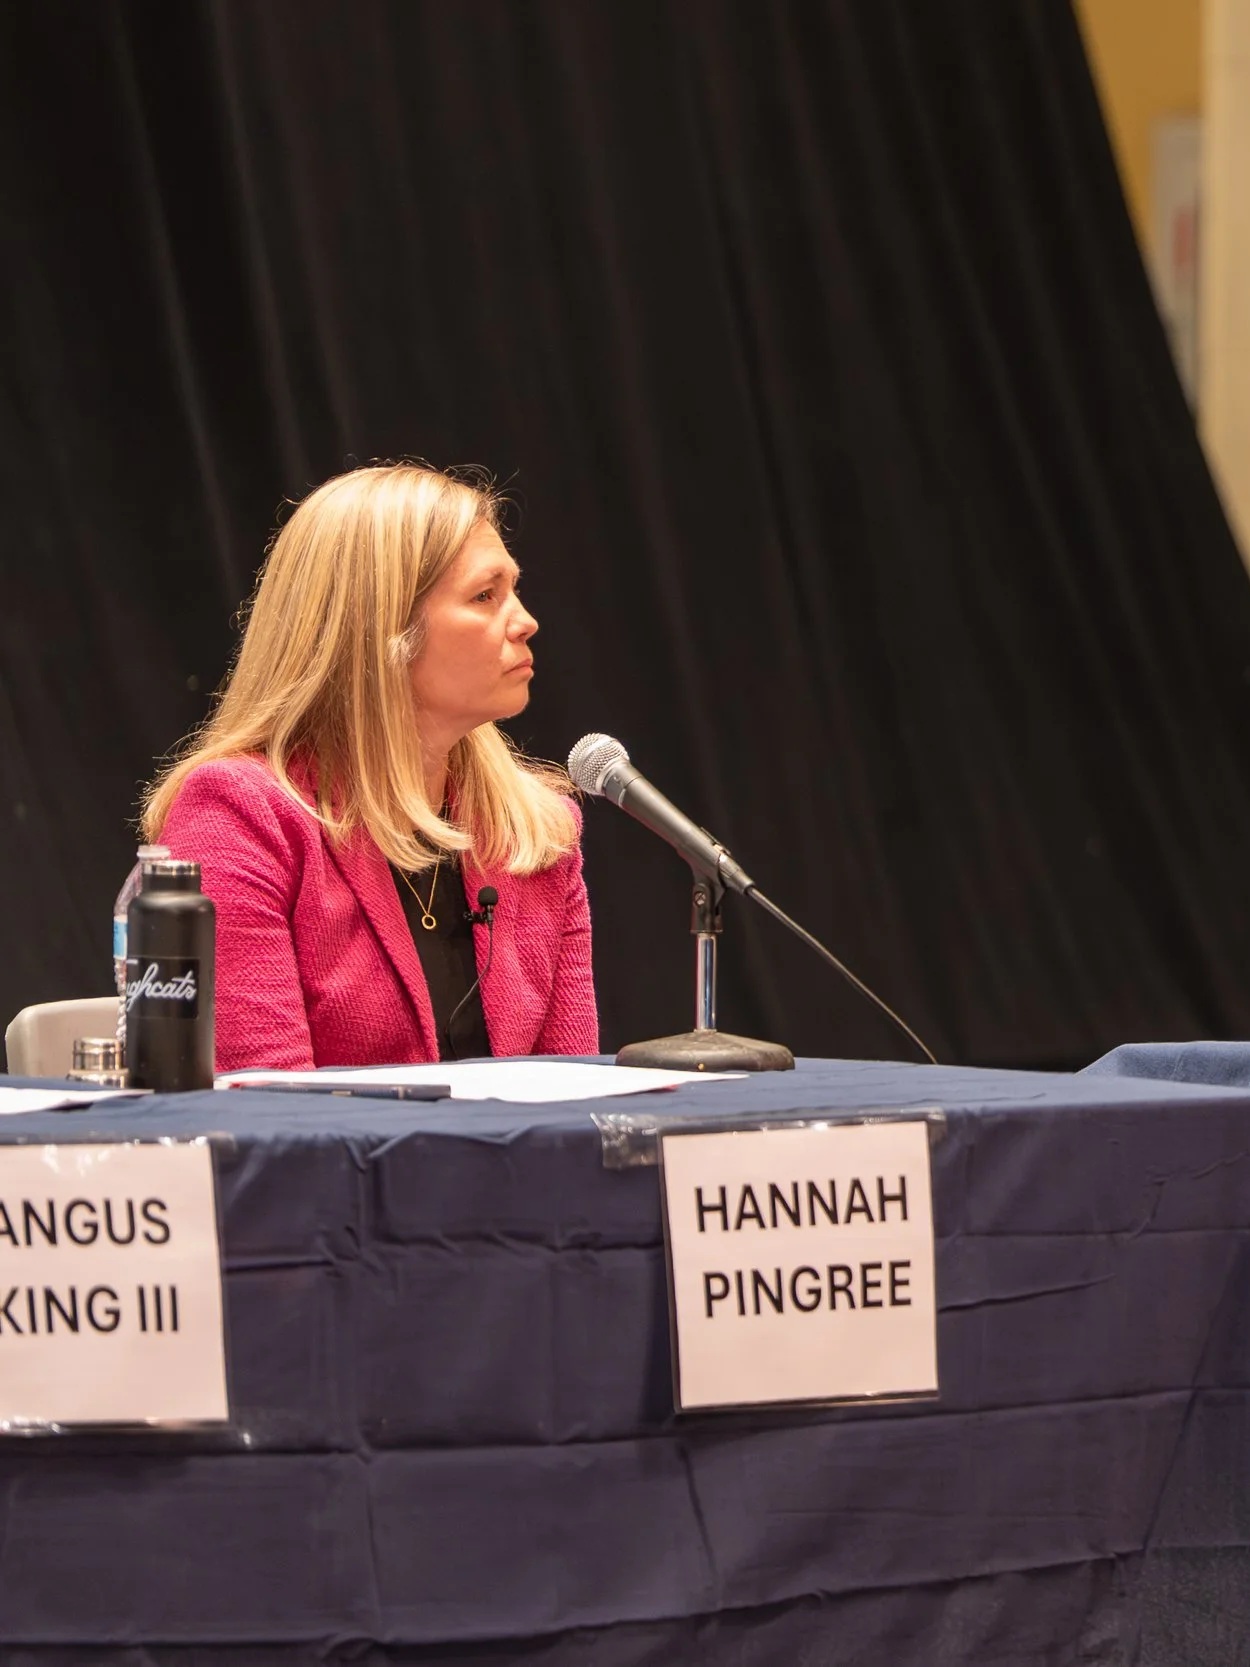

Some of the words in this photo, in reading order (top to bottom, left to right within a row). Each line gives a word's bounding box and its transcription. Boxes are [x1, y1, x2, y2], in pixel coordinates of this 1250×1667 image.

[126, 959, 197, 1012] ghcats
[695, 1175, 909, 1233] HANNAH
[0, 1284, 122, 1335] KING
[137, 1284, 180, 1333] III
[703, 1259, 912, 1318] PINGREE
